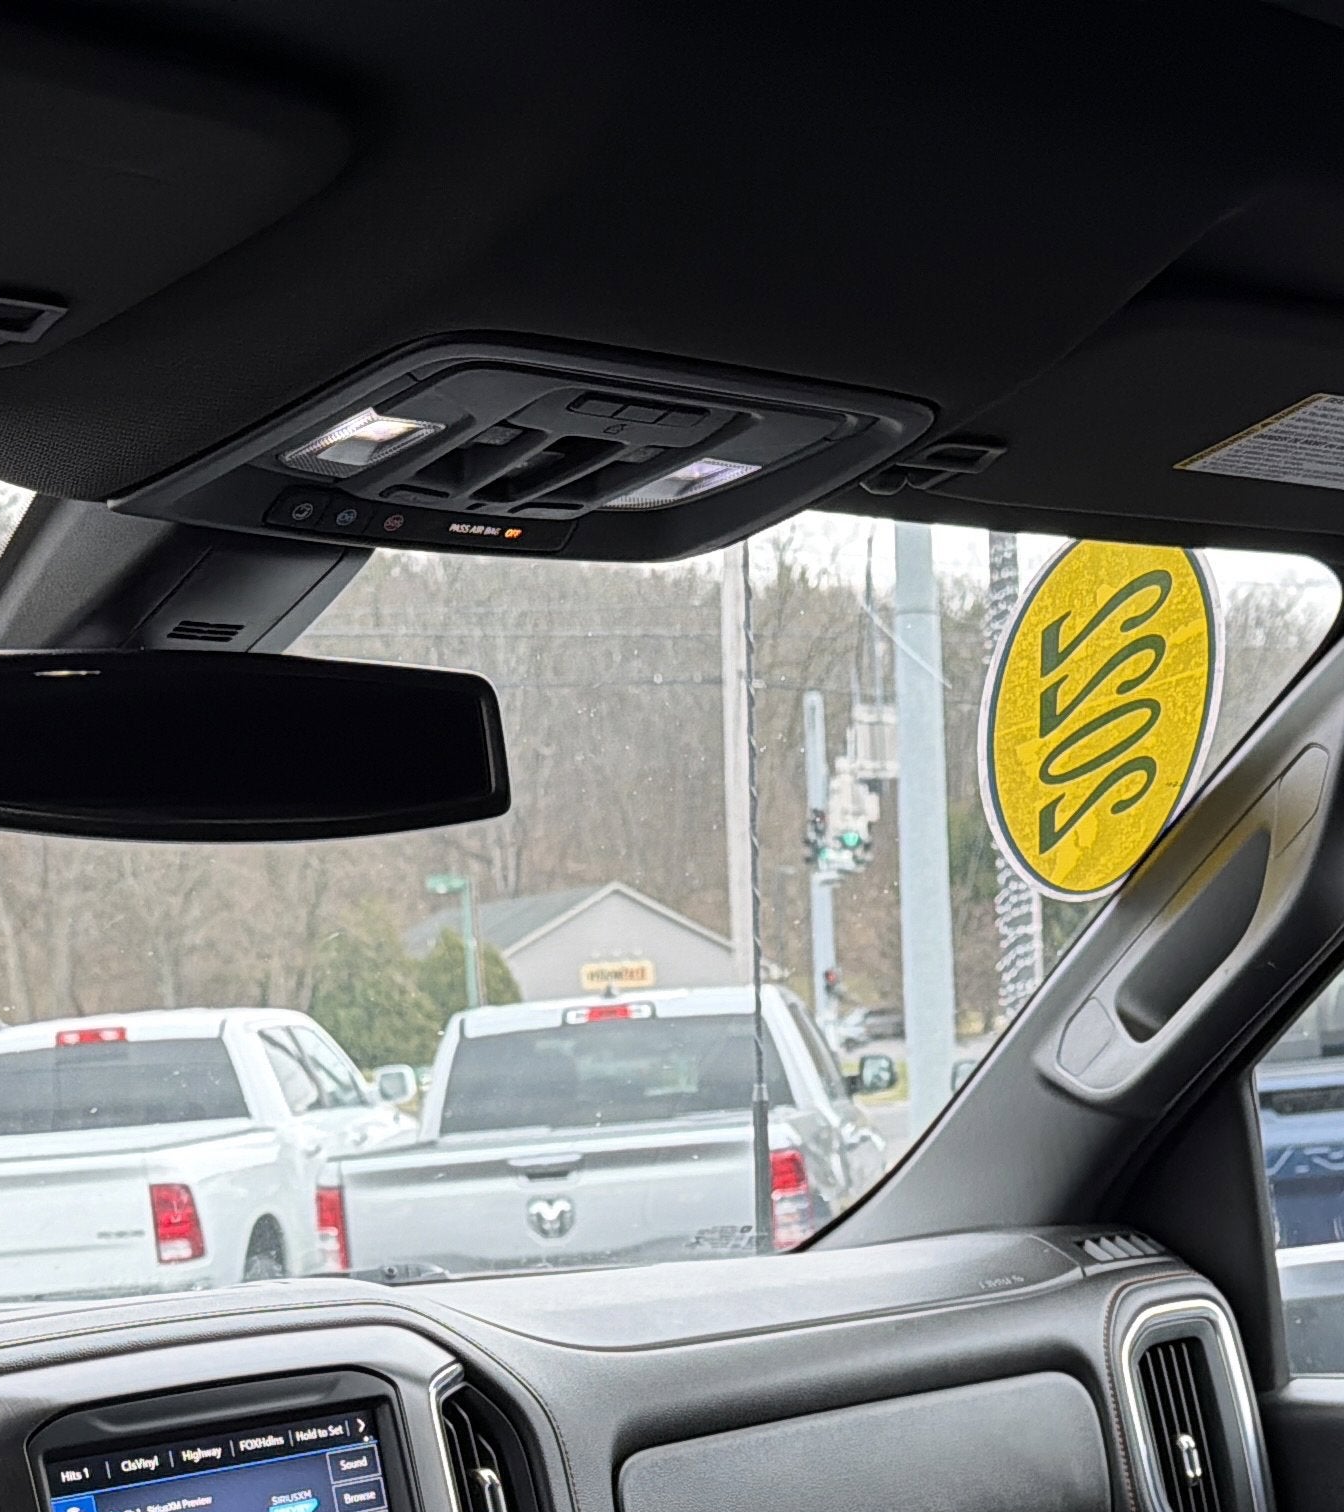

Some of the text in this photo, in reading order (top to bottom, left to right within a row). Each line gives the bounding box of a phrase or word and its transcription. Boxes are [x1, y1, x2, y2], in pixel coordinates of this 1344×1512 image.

[448, 523, 471, 534] PASS
[469, 525, 485, 535] AIR
[504, 528, 523, 539] OFF
[295, 1424, 345, 1442] Hold to Set
[181, 1446, 223, 1464] Highway
[120, 1455, 159, 1473] ClsVinyl
[339, 1456, 369, 1471] Sound
[60, 1467, 90, 1483] Hits 1
[181, 1496, 213, 1510] Preview
[343, 1490, 377, 1505] Browse
